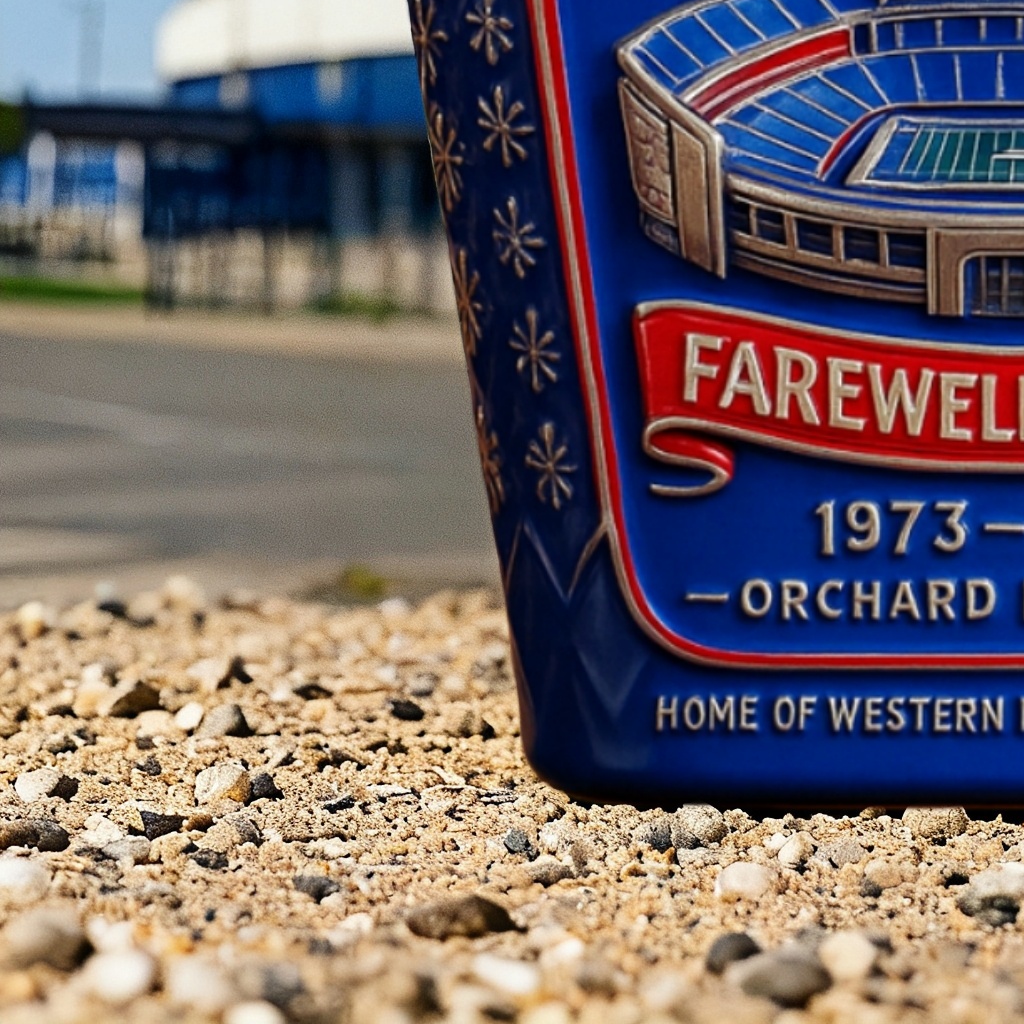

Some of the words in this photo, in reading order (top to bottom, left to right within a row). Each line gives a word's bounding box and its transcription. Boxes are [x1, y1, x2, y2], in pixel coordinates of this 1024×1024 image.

[655, 694, 760, 731] HOME
[773, 694, 818, 731] OF
[828, 694, 1005, 732] WESTERN
